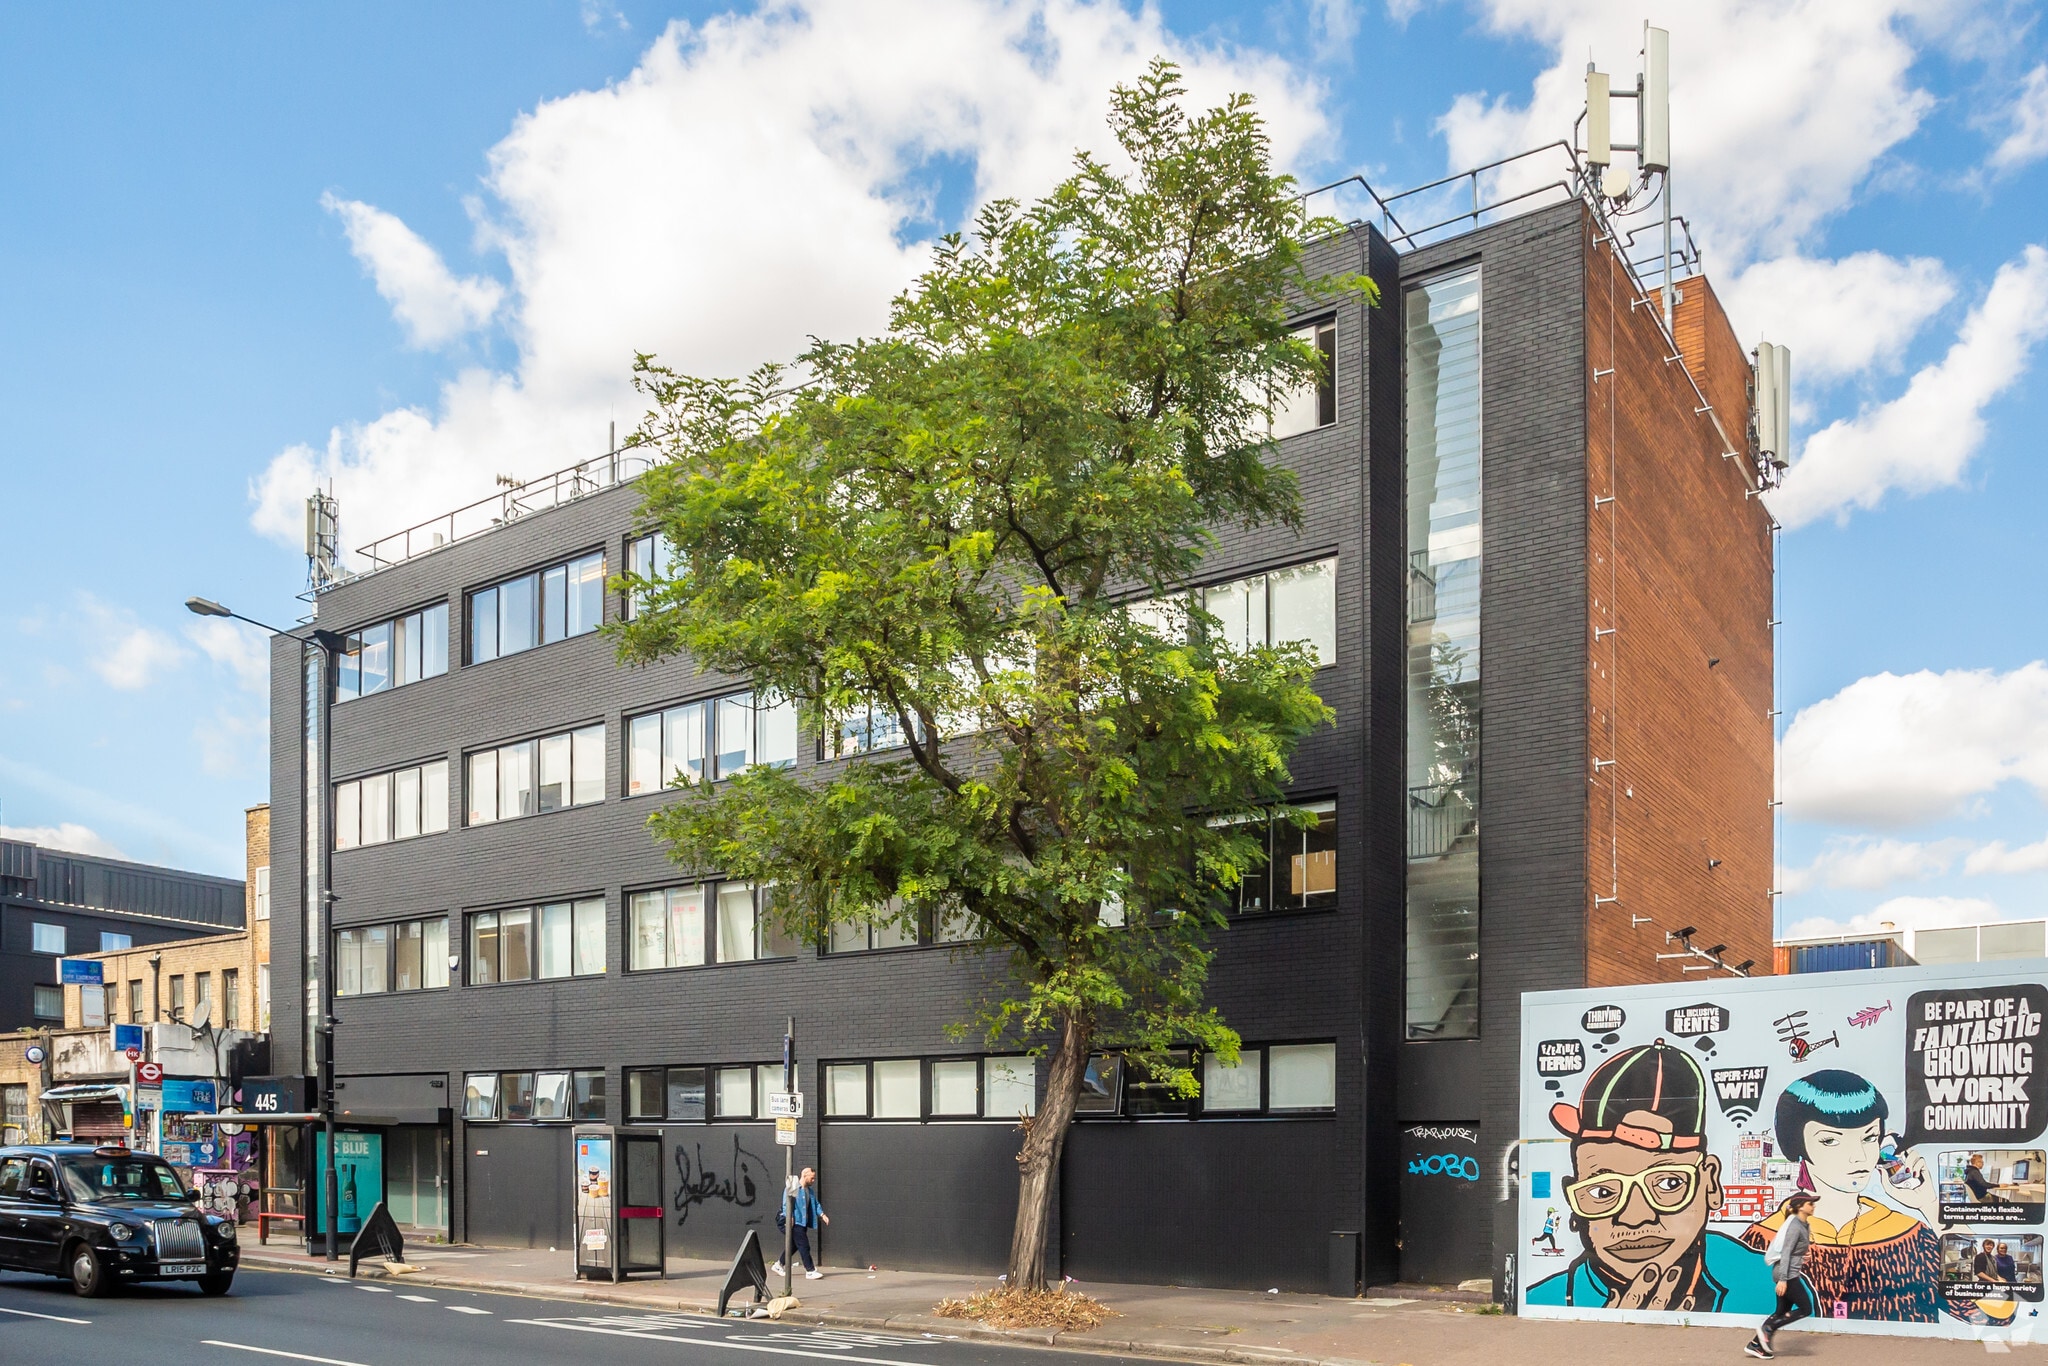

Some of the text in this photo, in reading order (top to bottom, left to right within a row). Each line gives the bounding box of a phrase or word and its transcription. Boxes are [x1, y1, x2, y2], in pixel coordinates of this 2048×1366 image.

[1587, 1005, 1622, 1023] THRIVING
[1674, 1007, 1720, 1018] ALL INCLUSIVE
[1925, 997, 2030, 1021] BE PART OF A
[1673, 1016, 1720, 1033] RENTS
[1913, 1012, 2042, 1052] FANTASTIC
[1541, 1043, 1580, 1056] FLEXIBLE
[1539, 1055, 1582, 1072] TERMS
[1924, 1042, 2033, 1077] GROWING
[1714, 1067, 1764, 1083] SUPER-FAST
[1717, 1081, 1759, 1099] WIFI
[1924, 1075, 2030, 1104] WORK
[255, 1093, 277, 1111] 445
[1924, 1103, 2030, 1131] COMMUNITY
[342, 1141, 369, 1155] BLUE
[1943, 1205, 1997, 1213] Containerville's
[165, 1265, 202, 1274] LR15 PZC
[1974, 1282, 1985, 1290] for
[1992, 1283, 2010, 1292] huge
[2011, 1285, 2037, 1293] variety
